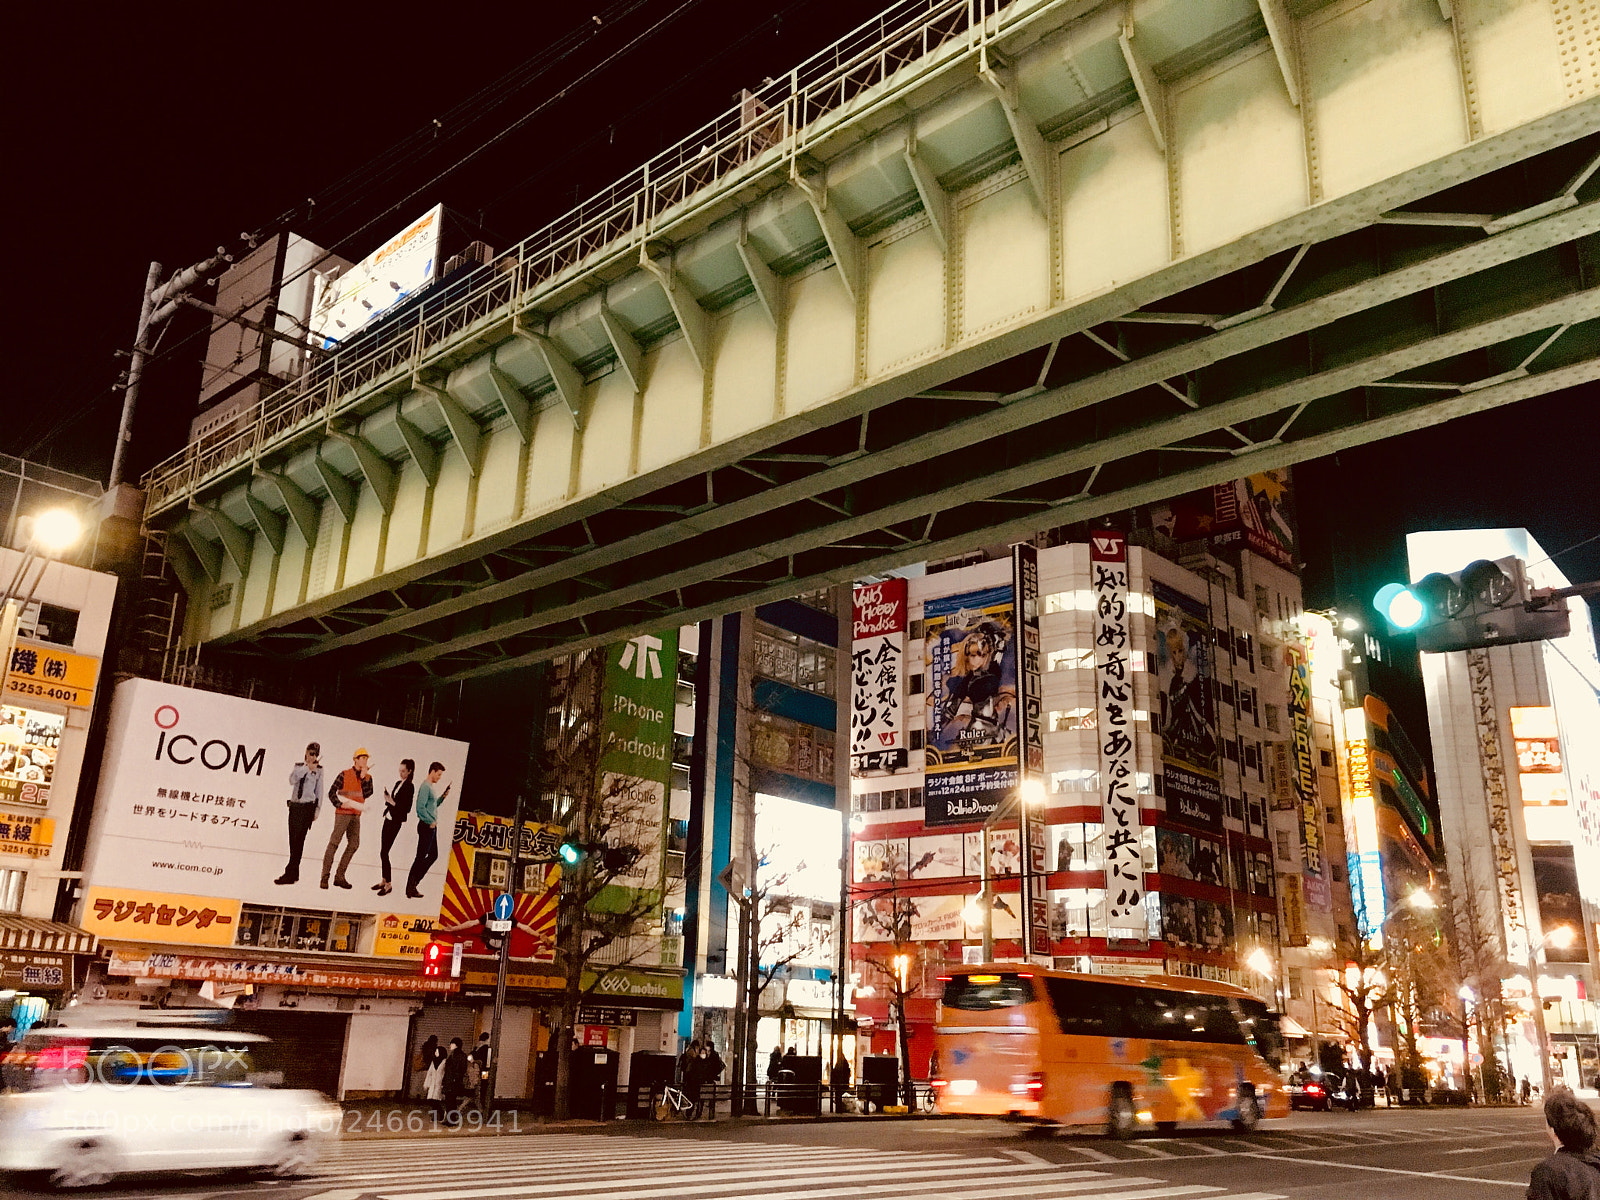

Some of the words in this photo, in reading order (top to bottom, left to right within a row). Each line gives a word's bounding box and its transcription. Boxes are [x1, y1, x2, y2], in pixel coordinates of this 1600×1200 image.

[1288, 648, 1306, 710] TAX
[613, 694, 664, 723] iPhone
[607, 731, 666, 761] Android
[960, 728, 986, 740] Ruler
[1294, 711, 1312, 798] FREE
[156, 787, 247, 809] 無線機とIP技術で
[133, 803, 260, 830] 世界をリードするアイコム
[151, 860, 224, 876] www.icom.co.jp
[93, 898, 232, 930] ラジオセンター
[630, 982, 668, 996] mobile
